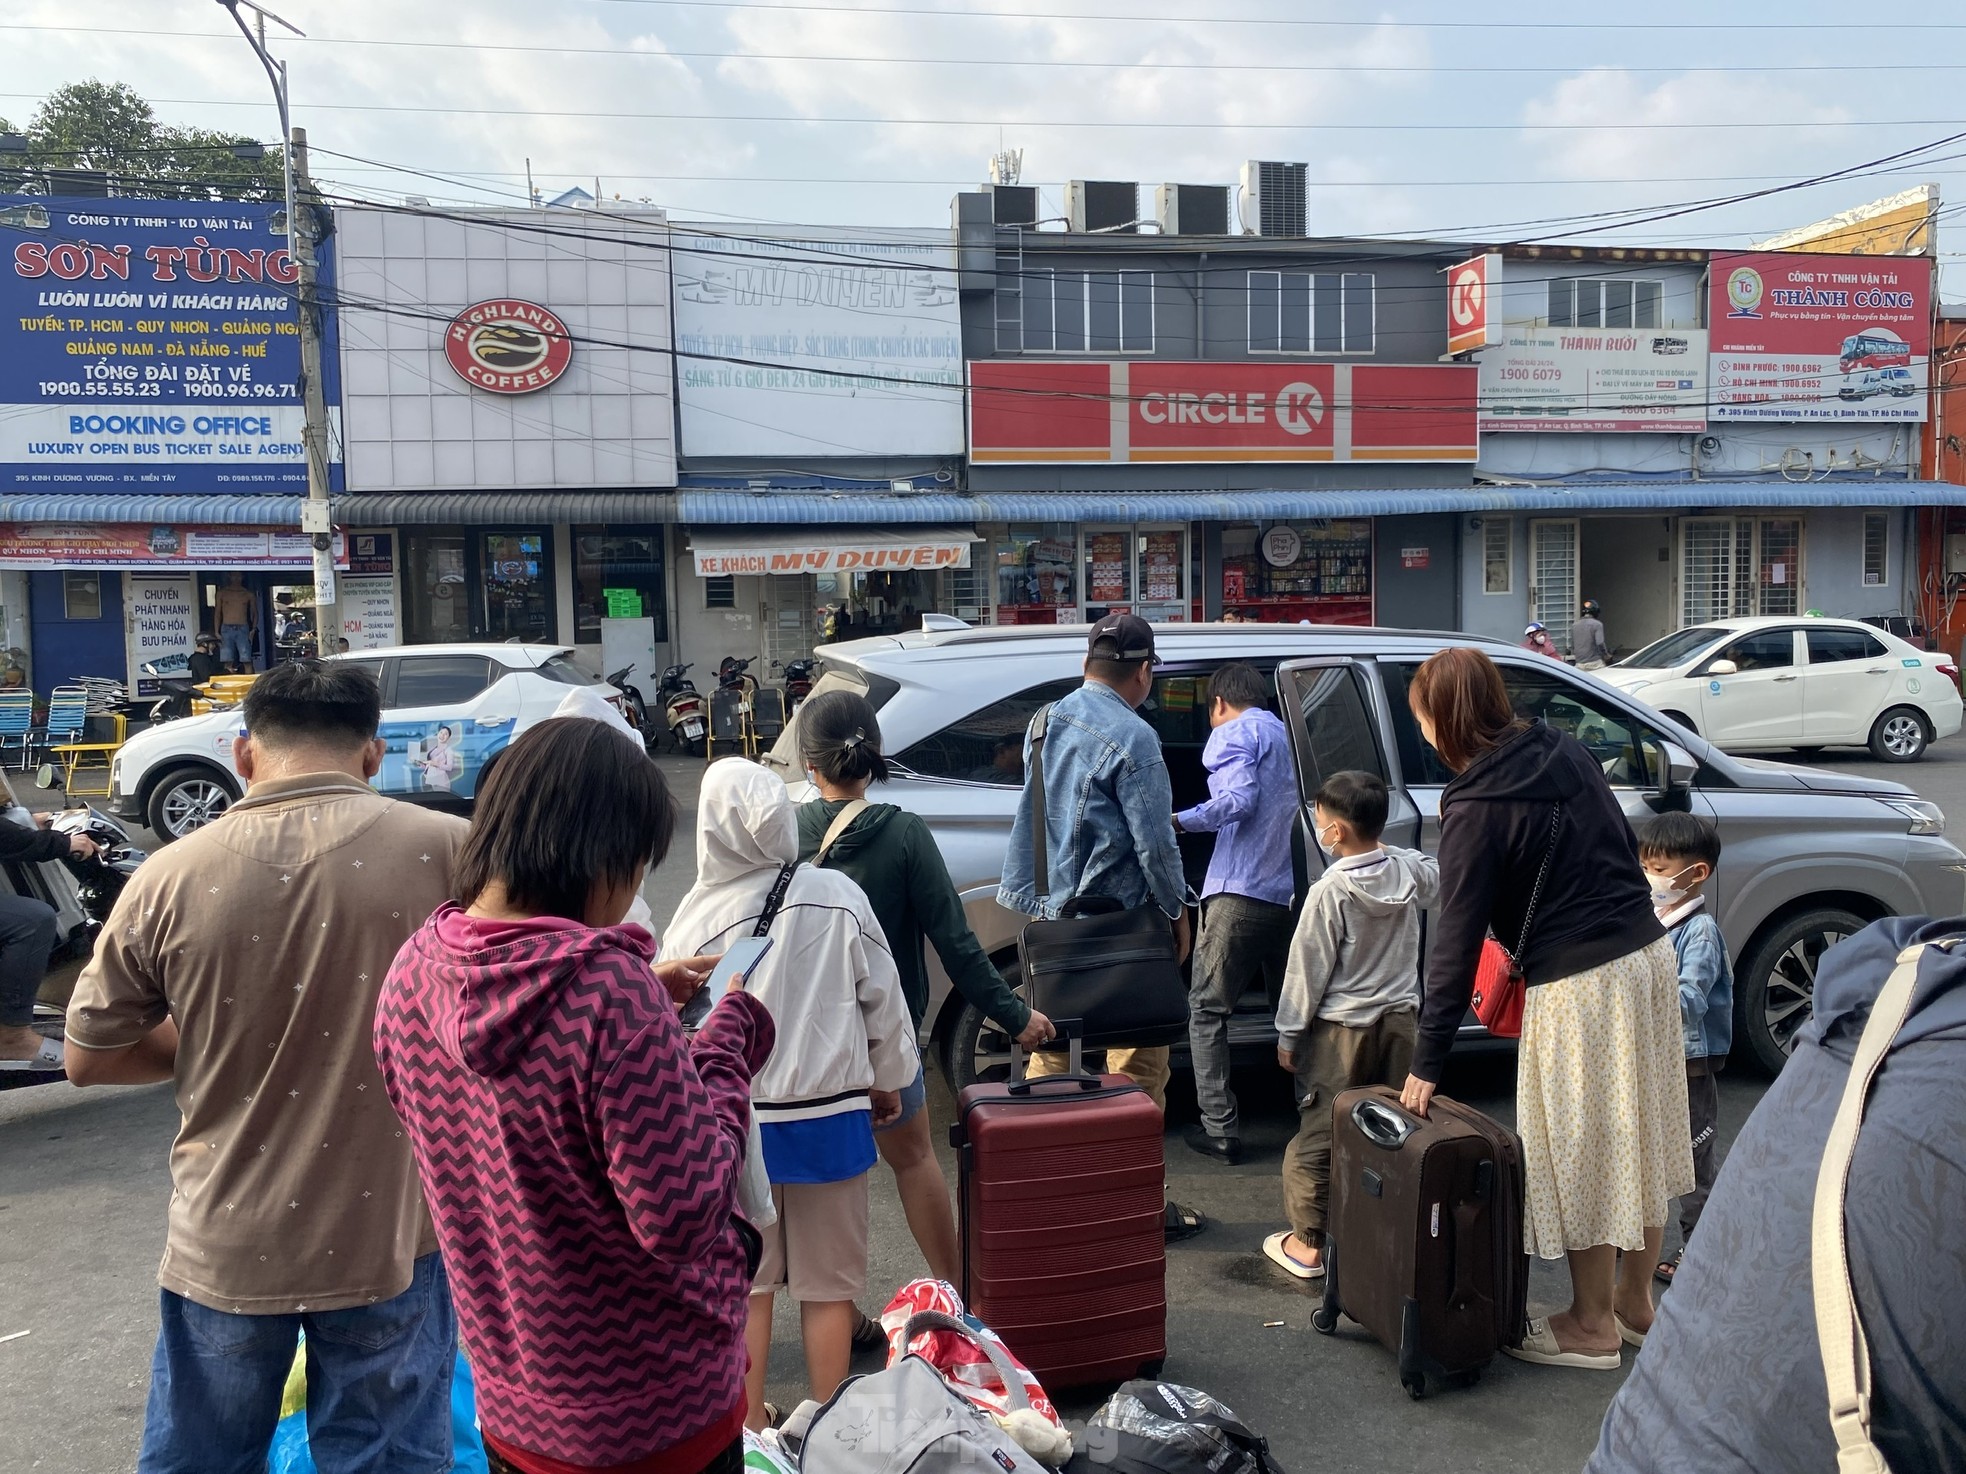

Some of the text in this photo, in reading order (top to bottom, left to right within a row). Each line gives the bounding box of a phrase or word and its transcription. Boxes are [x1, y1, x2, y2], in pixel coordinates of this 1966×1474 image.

[67, 211, 252, 232] CÔNG TY TNHH KD VẬN TẢI
[14, 236, 300, 284] SƠN TÙNG
[735, 260, 908, 308] MỸ DUYÊN
[1788, 270, 1898, 286] CÔNG TY TNHH VẬN TẢI
[38, 290, 288, 311] LUÔN LUÔN VÌ KHÁCH HÀNG
[1454, 271, 1481, 323] K
[1770, 286, 1914, 308] THÀNH CÔNG
[20, 314, 272, 335] TUYẾN: TP. HCM QUY NHƠN QUẢNG
[452, 304, 563, 344] HIGHLANDS
[66, 337, 268, 358] QUẢNG NAM ĐÀ NẴNG HUẾ
[1560, 334, 1602, 350] THÀNH
[83, 357, 252, 385] TỔNG ĐÀI ĐẶT VÉ
[467, 365, 554, 388] COFFEE
[685, 365, 714, 388] SÁNG
[735, 370, 742, 388] 6
[792, 371, 806, 388] 24
[1500, 368, 1562, 380] 1900 6079
[1732, 362, 1750, 371] BÌNH
[38, 382, 297, 398] 1900.55.55.23 1900.96.96.71
[1140, 387, 1323, 434] CIRCLE K
[70, 415, 272, 436] BOOKING OFFICE
[28, 442, 306, 455] LUXURY OPEN BUS TICKET SALE AGENT
[15, 474, 30, 482] 395
[32, 474, 51, 482] KINH
[700, 546, 962, 572] XE KHÁCH MỸ DUYÊN
[144, 586, 179, 600] CHUYỂN
[135, 603, 190, 615] PHÁT NHANH
[142, 618, 186, 631] HÀNG HÓA
[344, 620, 362, 632] HCM
[142, 633, 186, 646] BƯU PHẨM
